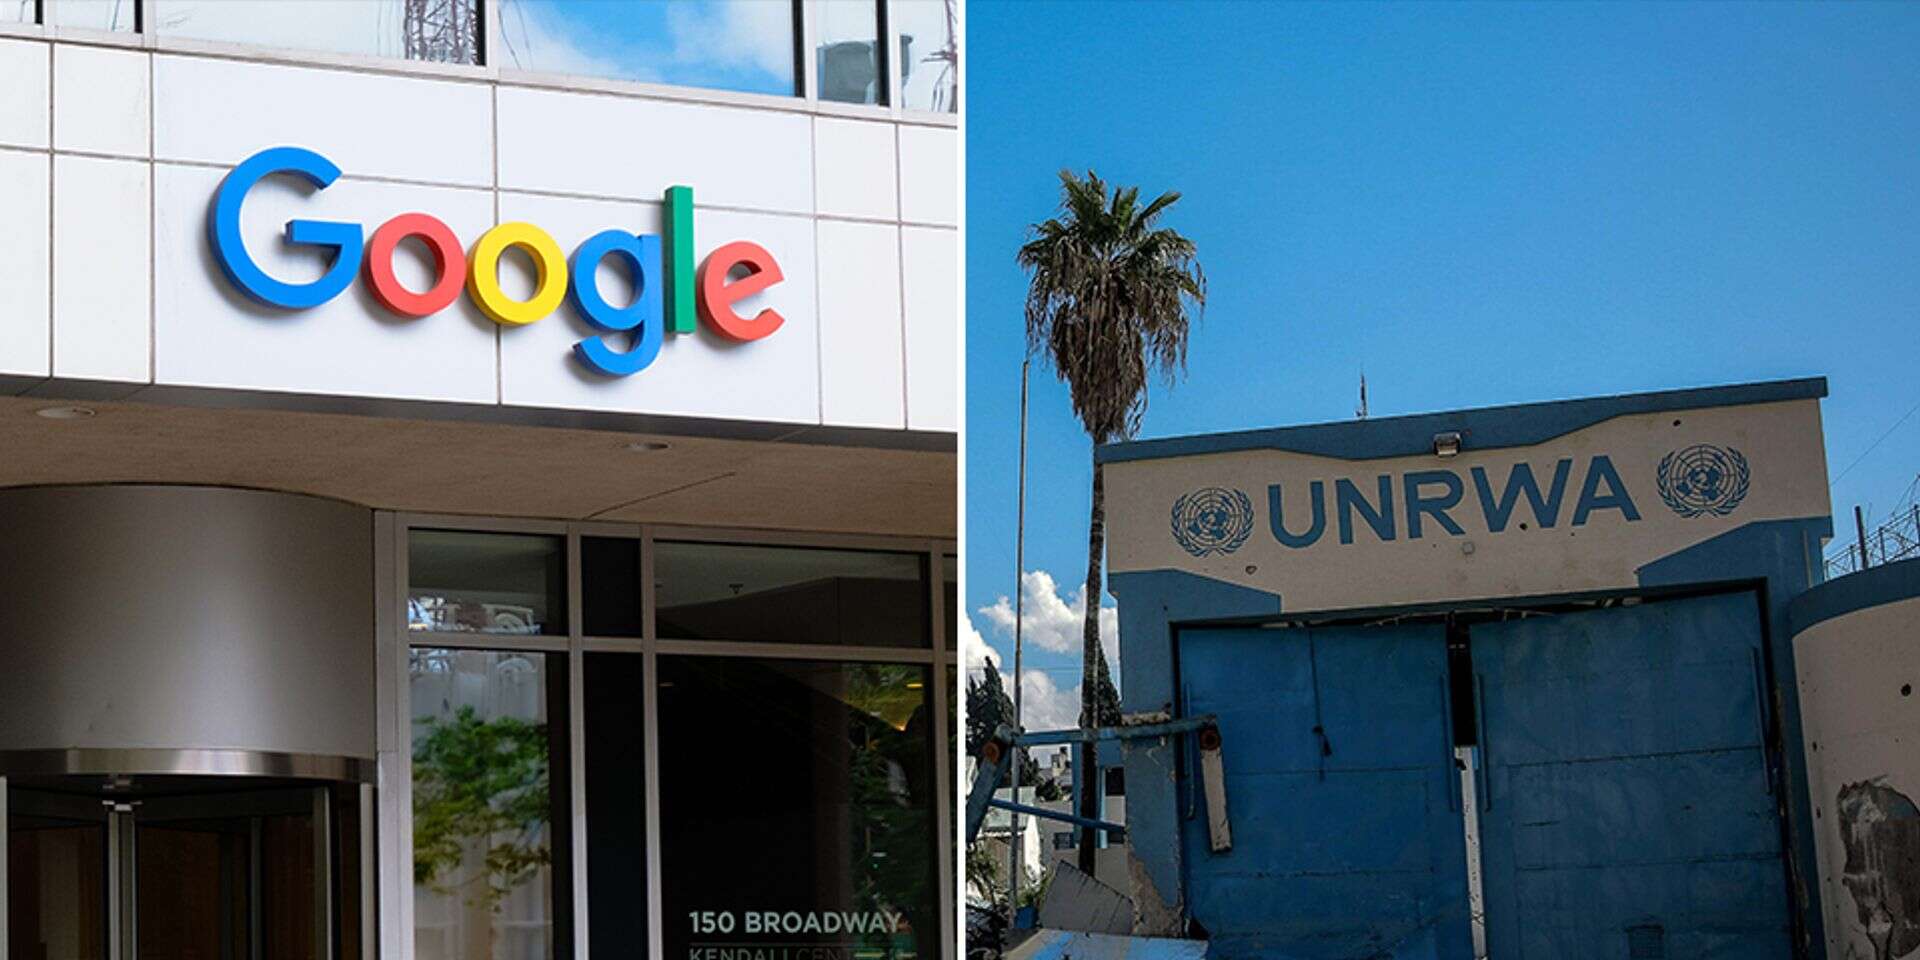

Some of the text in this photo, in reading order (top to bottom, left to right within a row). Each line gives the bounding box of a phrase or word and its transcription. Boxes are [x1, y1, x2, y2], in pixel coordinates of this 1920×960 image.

[207, 146, 785, 375] Google
[1268, 456, 1641, 549] UNRWA
[689, 911, 902, 933] 150 BROADWAY
